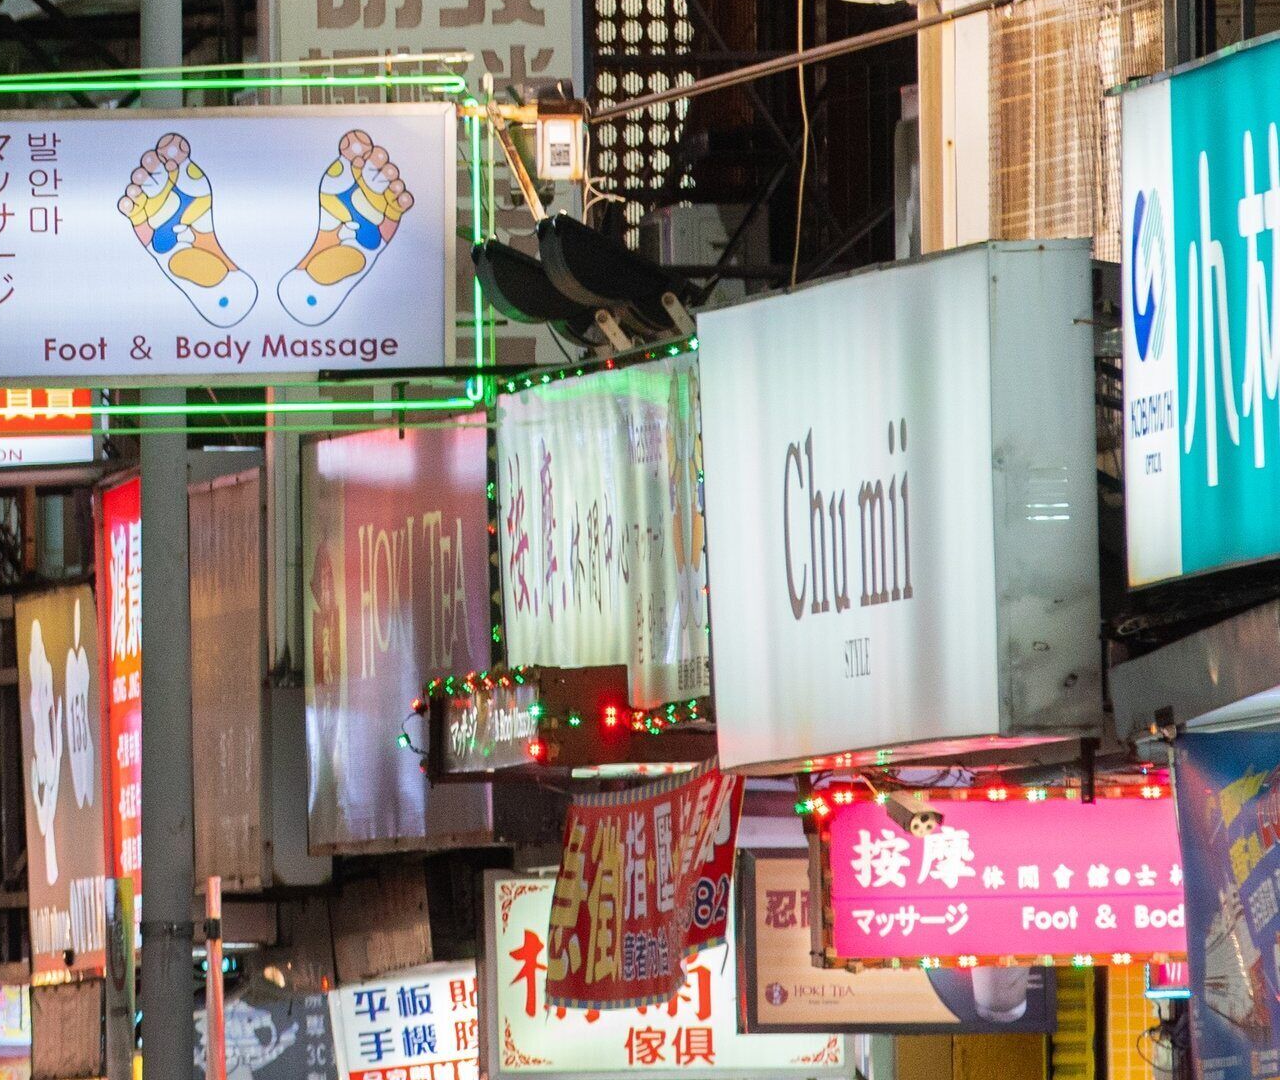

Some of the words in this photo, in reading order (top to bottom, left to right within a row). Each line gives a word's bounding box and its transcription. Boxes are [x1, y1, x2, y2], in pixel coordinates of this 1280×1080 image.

[27, 132, 63, 235] 발안마
[44, 338, 109, 362] Foot
[130, 336, 153, 361] &
[175, 334, 251, 365] Body
[261, 333, 399, 364] Massage
[423, 510, 475, 669] TEA
[844, 637, 872, 679] STYLE
[70, 692, 88, 756] 153
[850, 825, 976, 890] 按摩
[852, 903, 969, 937] マッサージ
[1022, 906, 1078, 930] Foot
[1095, 904, 1118, 929] &
[353, 982, 434, 1022] 平板
[358, 1022, 437, 1063] 手機
[624, 1024, 717, 1066] 傢俱
